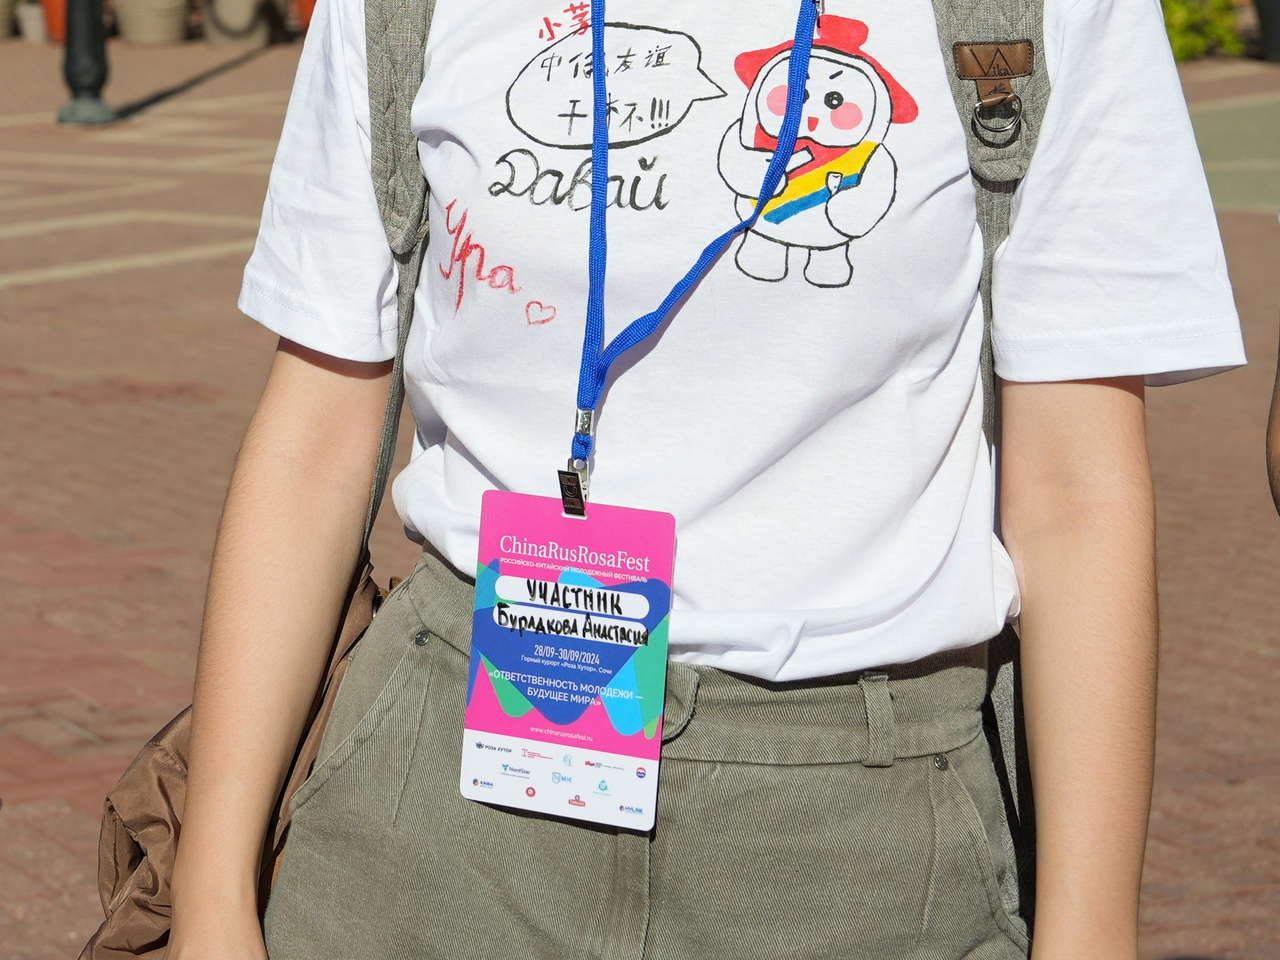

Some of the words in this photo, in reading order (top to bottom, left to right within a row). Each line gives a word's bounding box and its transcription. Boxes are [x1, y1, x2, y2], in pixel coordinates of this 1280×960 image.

[488, 148, 670, 211] Давай
[439, 198, 523, 320] Ура
[499, 535, 650, 572] ChinaRusRosaFest
[500, 557, 570, 572] РОССИЙСКО-КИТАЙСКИЙ
[571, 567, 613, 578] МОЛОДЕЖНЫЙ
[614, 572, 648, 583] ФЕСТИВАЛЬ
[526, 579, 623, 616] УЧАСТНИК
[521, 655, 541, 664] Горный
[541, 658, 560, 667] курорт
[598, 667, 613, 675] Сочи
[534, 644, 600, 665] 28/09-30/09/2024
[488, 670, 578, 691] «ОТВЕТСТВЕННОСТЬ
[580, 683, 633, 700] МОЛОДЕЖИ
[527, 687, 568, 702] БУДУЩЕЕ
[570, 694, 601, 707] МИРА»
[530, 726, 593, 742] www.chinarusrosafest.ru
